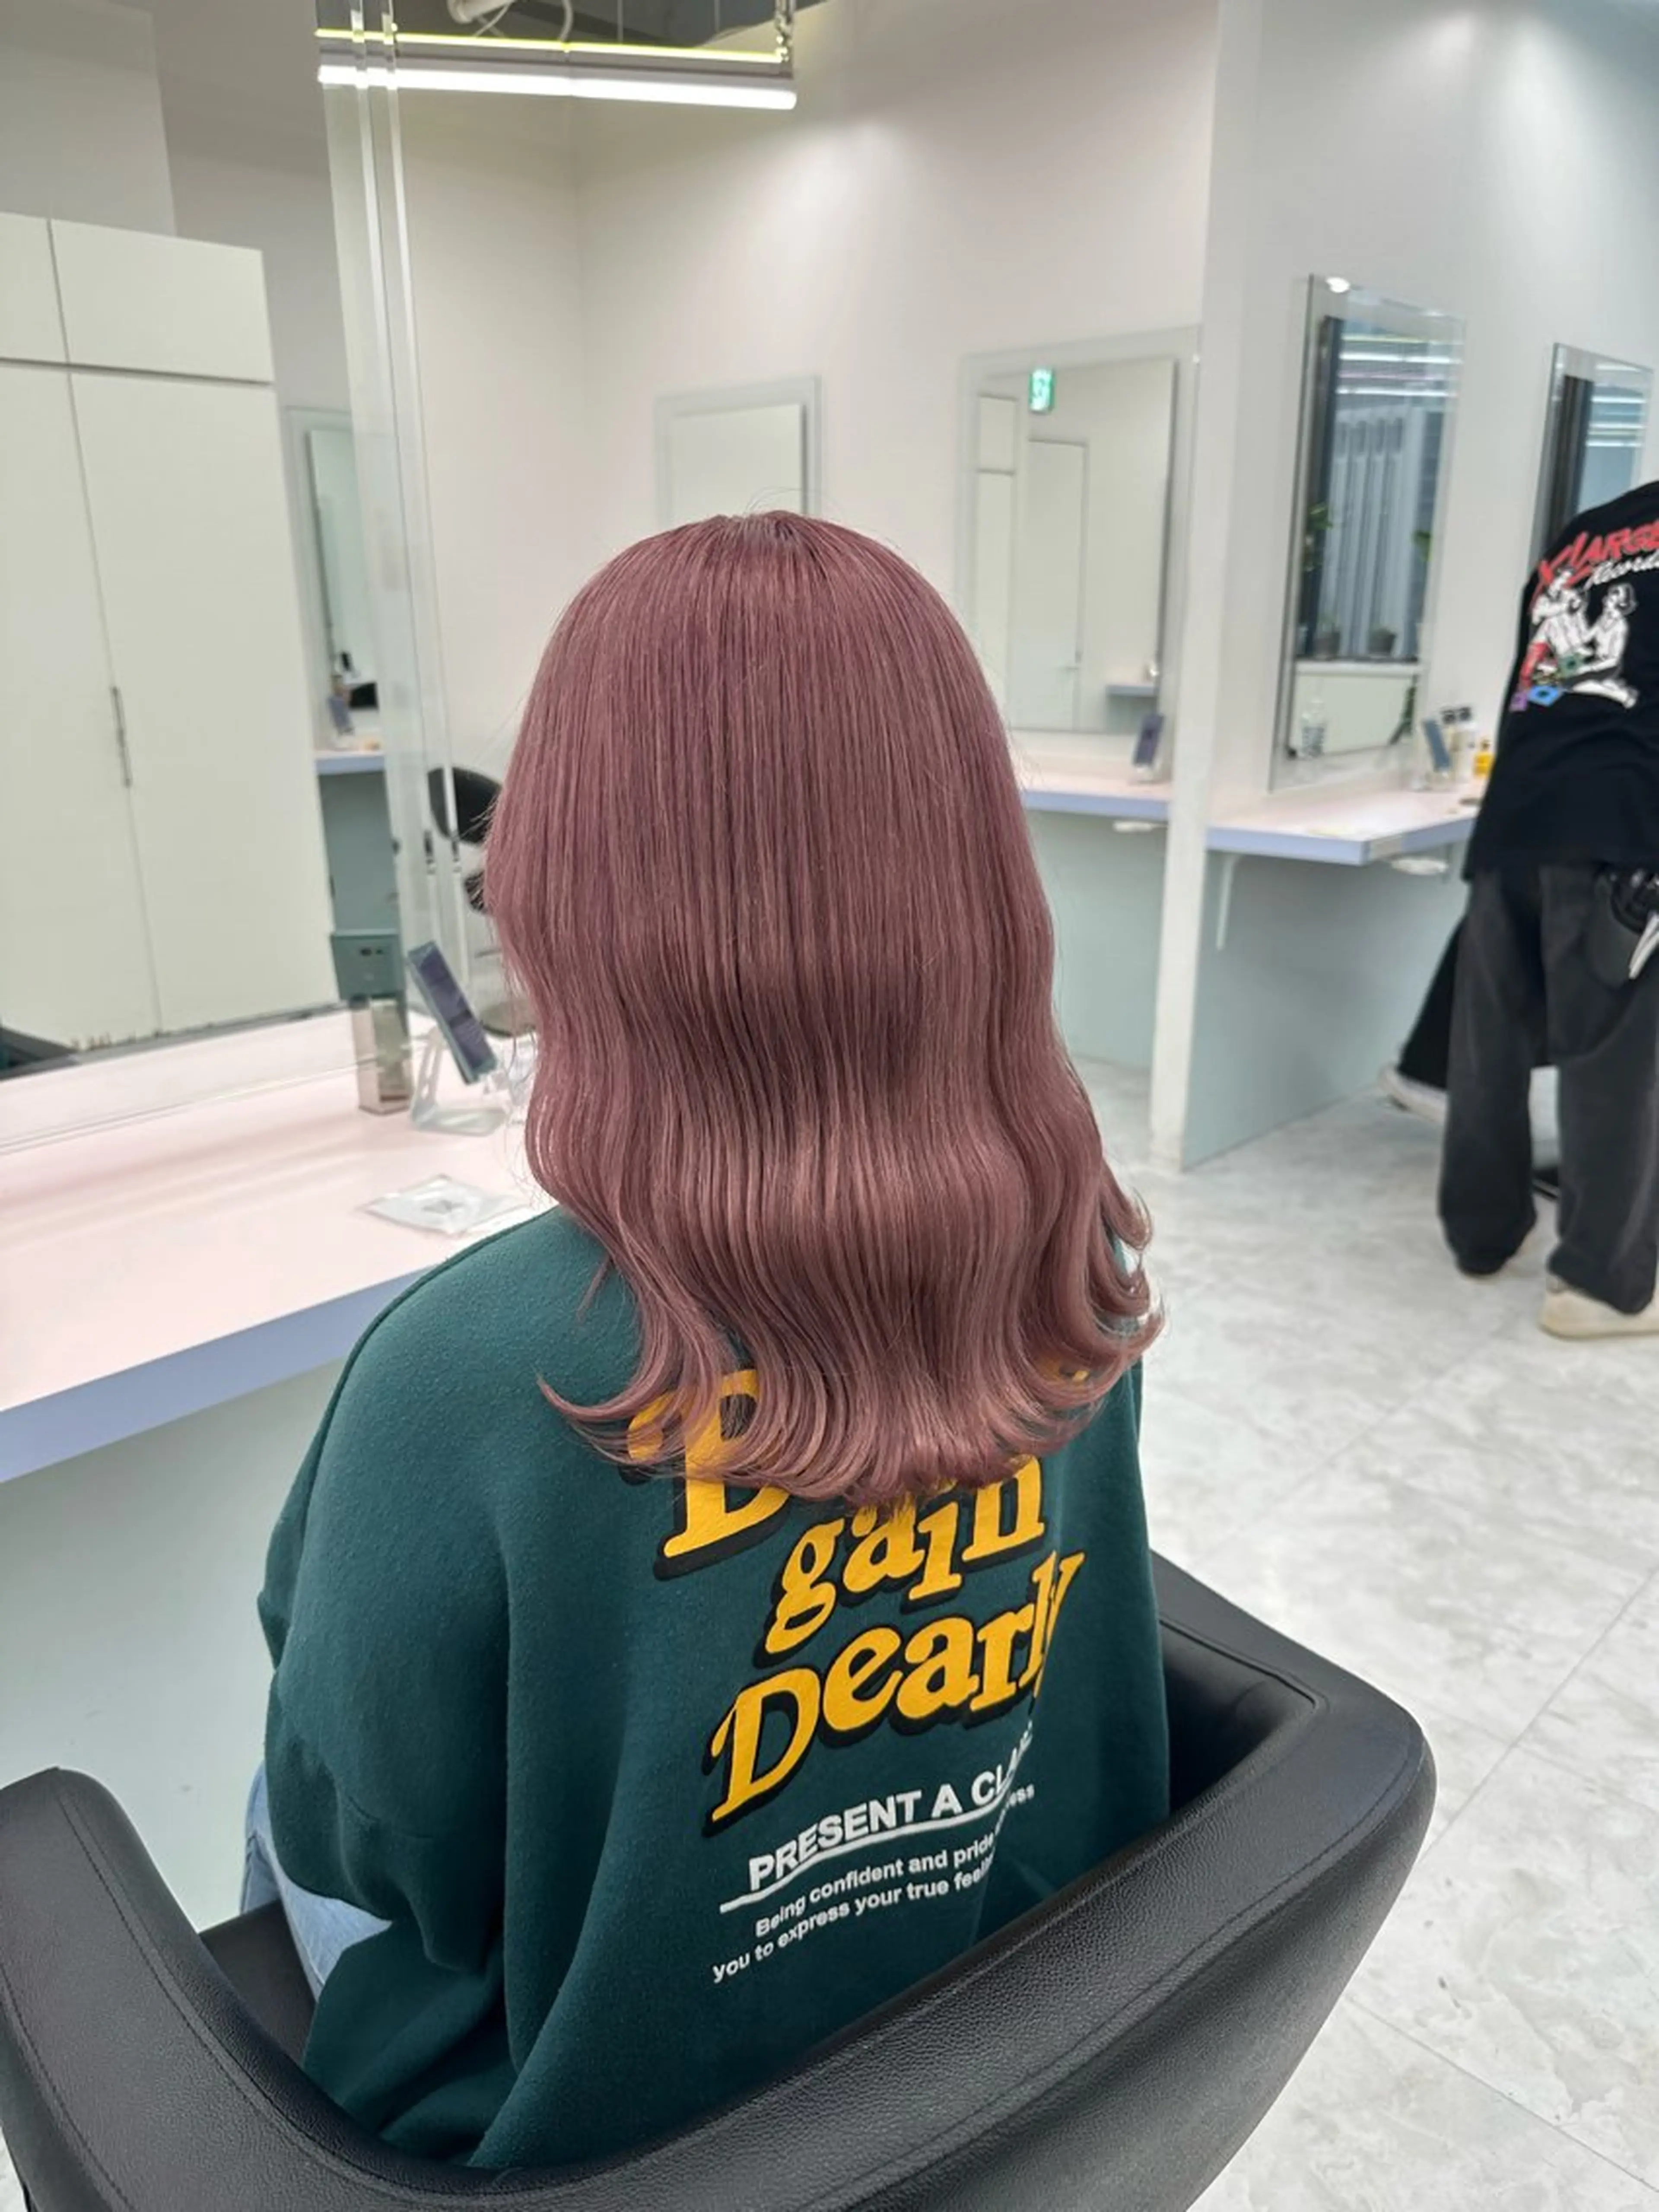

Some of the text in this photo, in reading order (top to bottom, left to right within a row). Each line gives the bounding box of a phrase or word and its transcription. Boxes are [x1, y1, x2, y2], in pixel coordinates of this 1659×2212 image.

[766, 1454, 1045, 1653] gain
[711, 1550, 1085, 1822] Dearly
[749, 1789, 922, 1891] PRESENT
[931, 1783, 963, 1819] A
[712, 1953, 750, 1984] you
[754, 1941, 775, 1962] to
[777, 1902, 851, 1948] express
[854, 1887, 903, 1916] your
[906, 1879, 949, 1900] true
[756, 1895, 806, 1937] Being
[809, 1859, 905, 1903] confident
[908, 1850, 948, 1875] and
